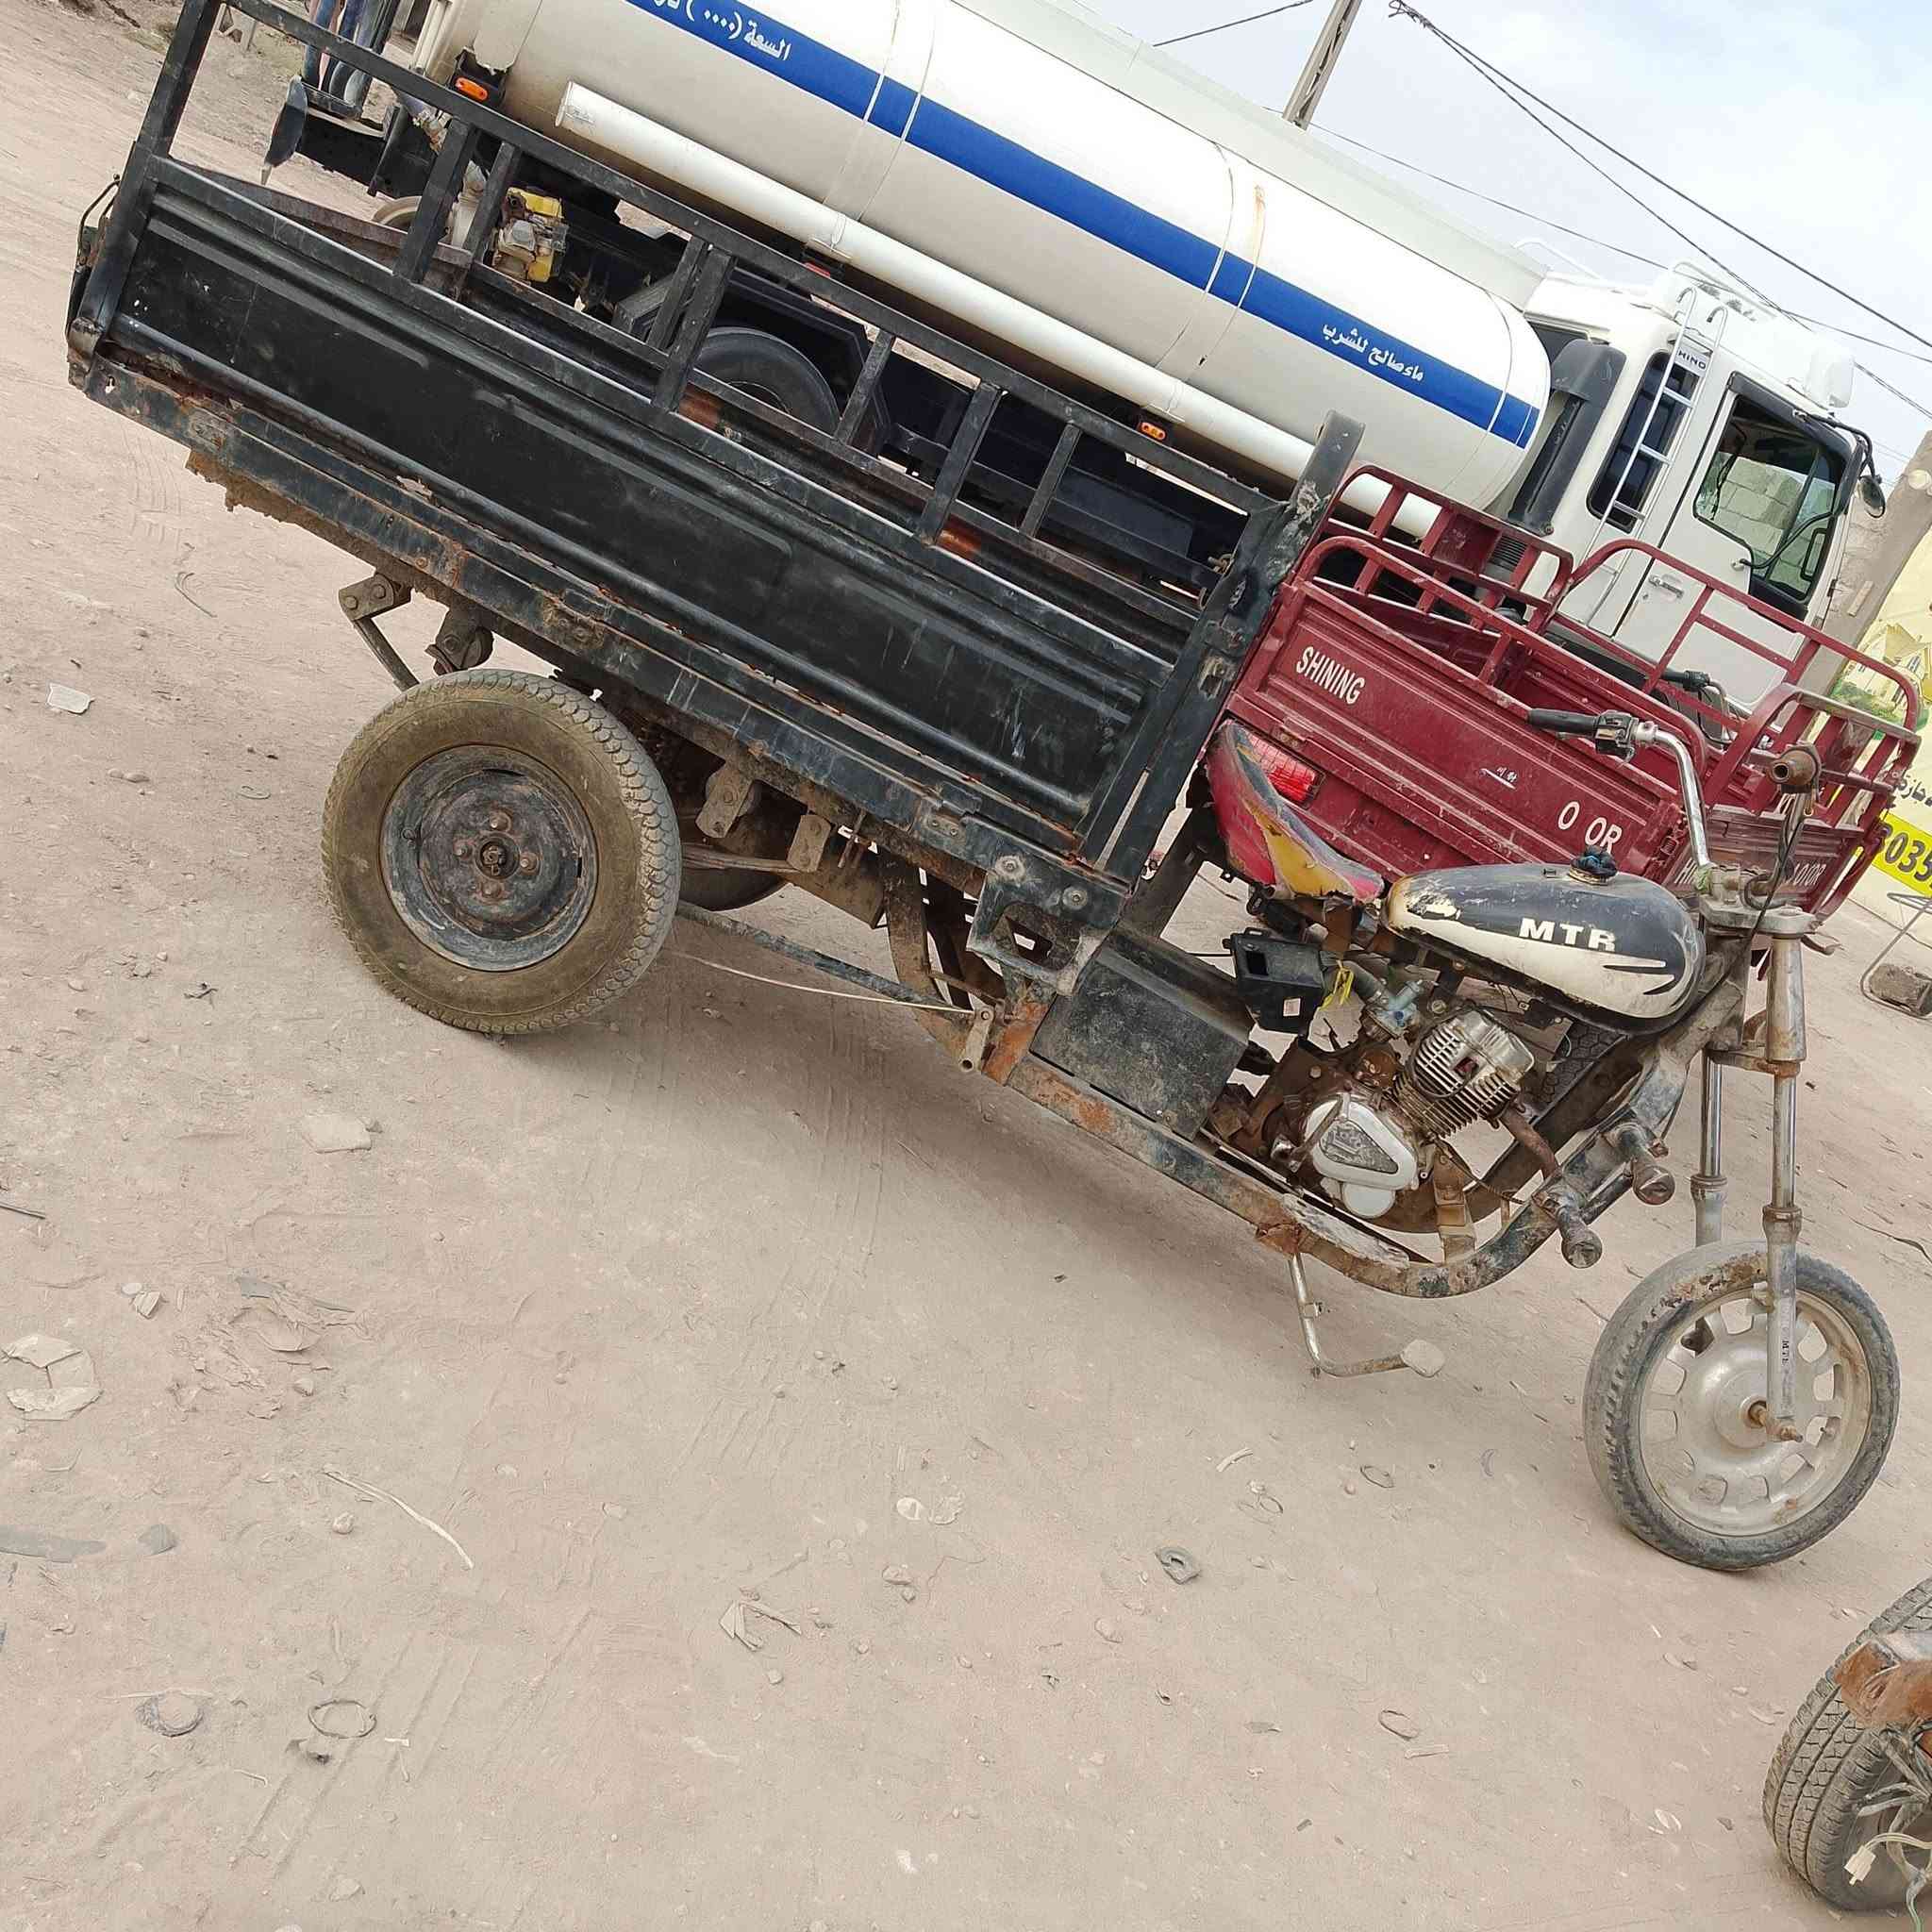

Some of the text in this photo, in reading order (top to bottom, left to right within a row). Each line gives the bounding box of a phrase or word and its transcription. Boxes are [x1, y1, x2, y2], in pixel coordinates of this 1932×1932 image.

[743, 20, 791, 60] السعة
[1322, 324, 1369, 353] للشرب
[1368, 347, 1405, 373] صالح
[1678, 350, 1707, 370] HINO
[1296, 646, 1365, 705] SHINING
[1519, 918, 1616, 952] MTR
